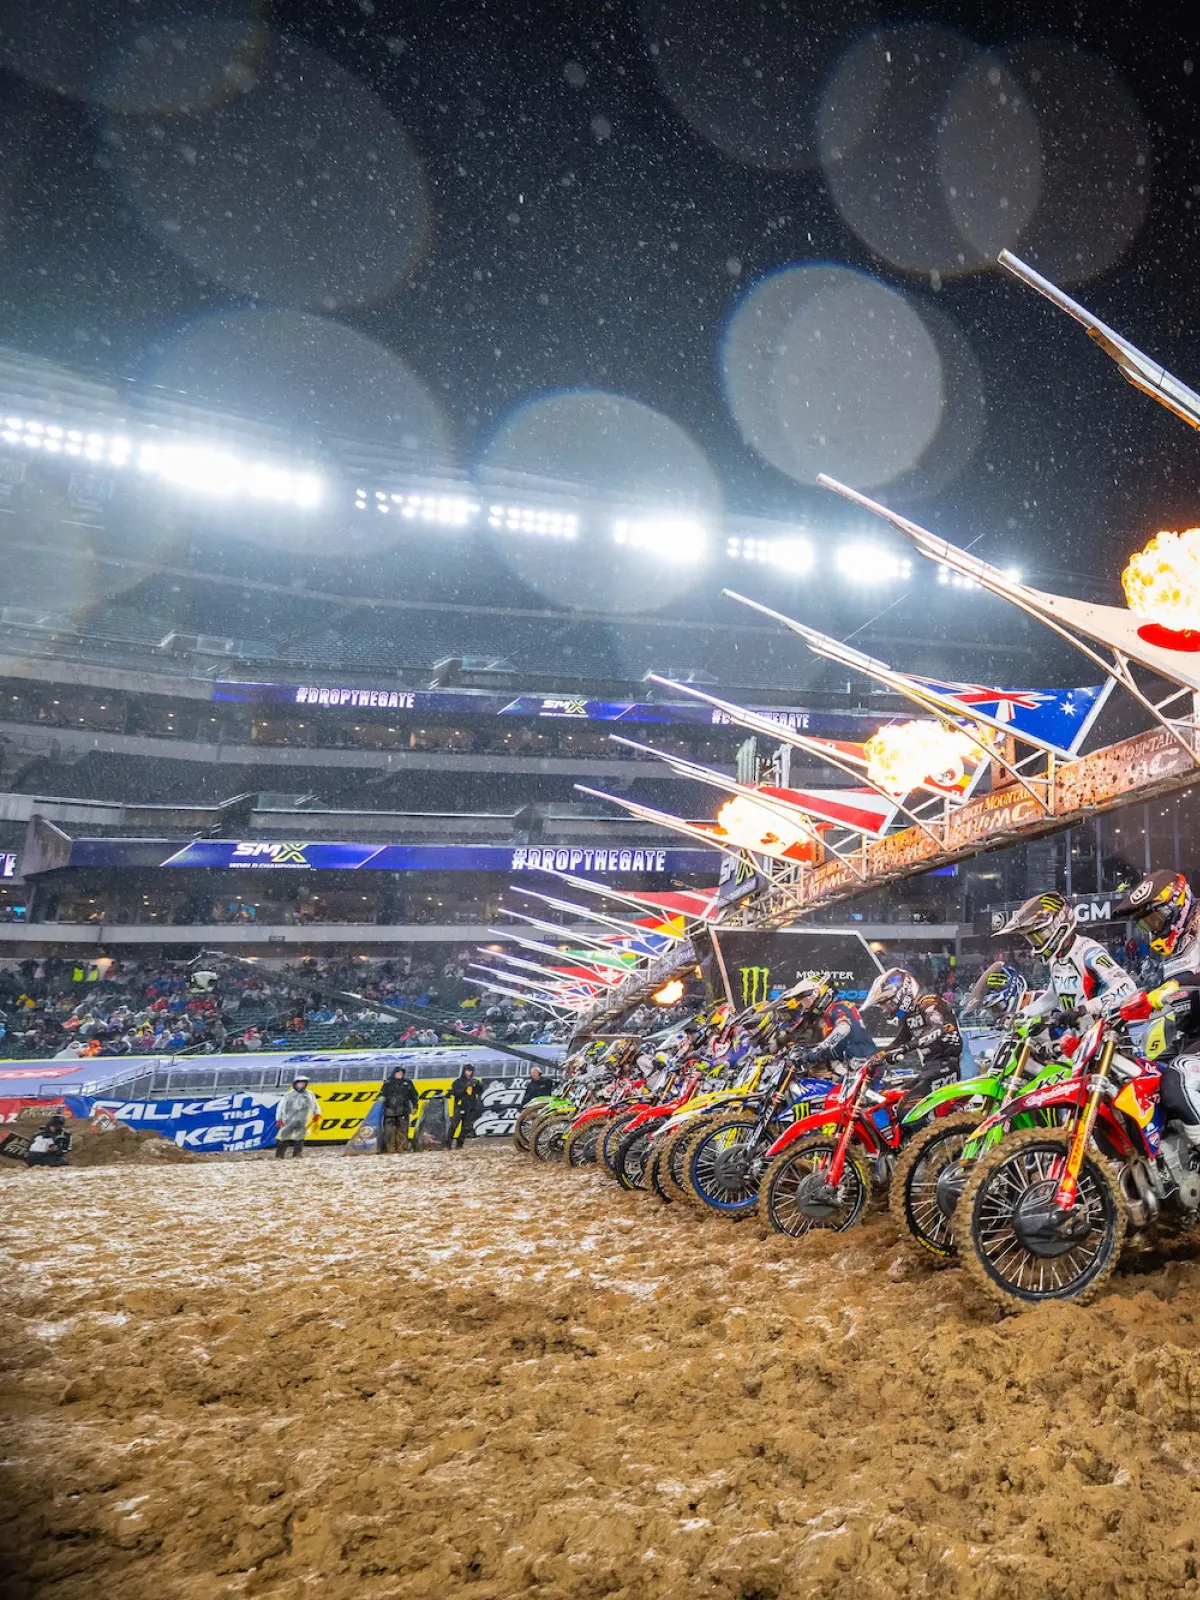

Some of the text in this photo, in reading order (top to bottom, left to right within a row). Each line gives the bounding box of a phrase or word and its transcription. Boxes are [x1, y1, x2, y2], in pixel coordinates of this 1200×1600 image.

[295, 688, 416, 708] #DROPTHEGATE
[540, 700, 588, 714] SMX
[232, 843, 309, 863] SMX
[512, 849, 667, 871] #DROPTHEGATE
[1074, 901, 1112, 922] GM
[222, 1108, 260, 1121] TIRES
[174, 1119, 266, 1147] KEN
[223, 1137, 262, 1152] TIRES
